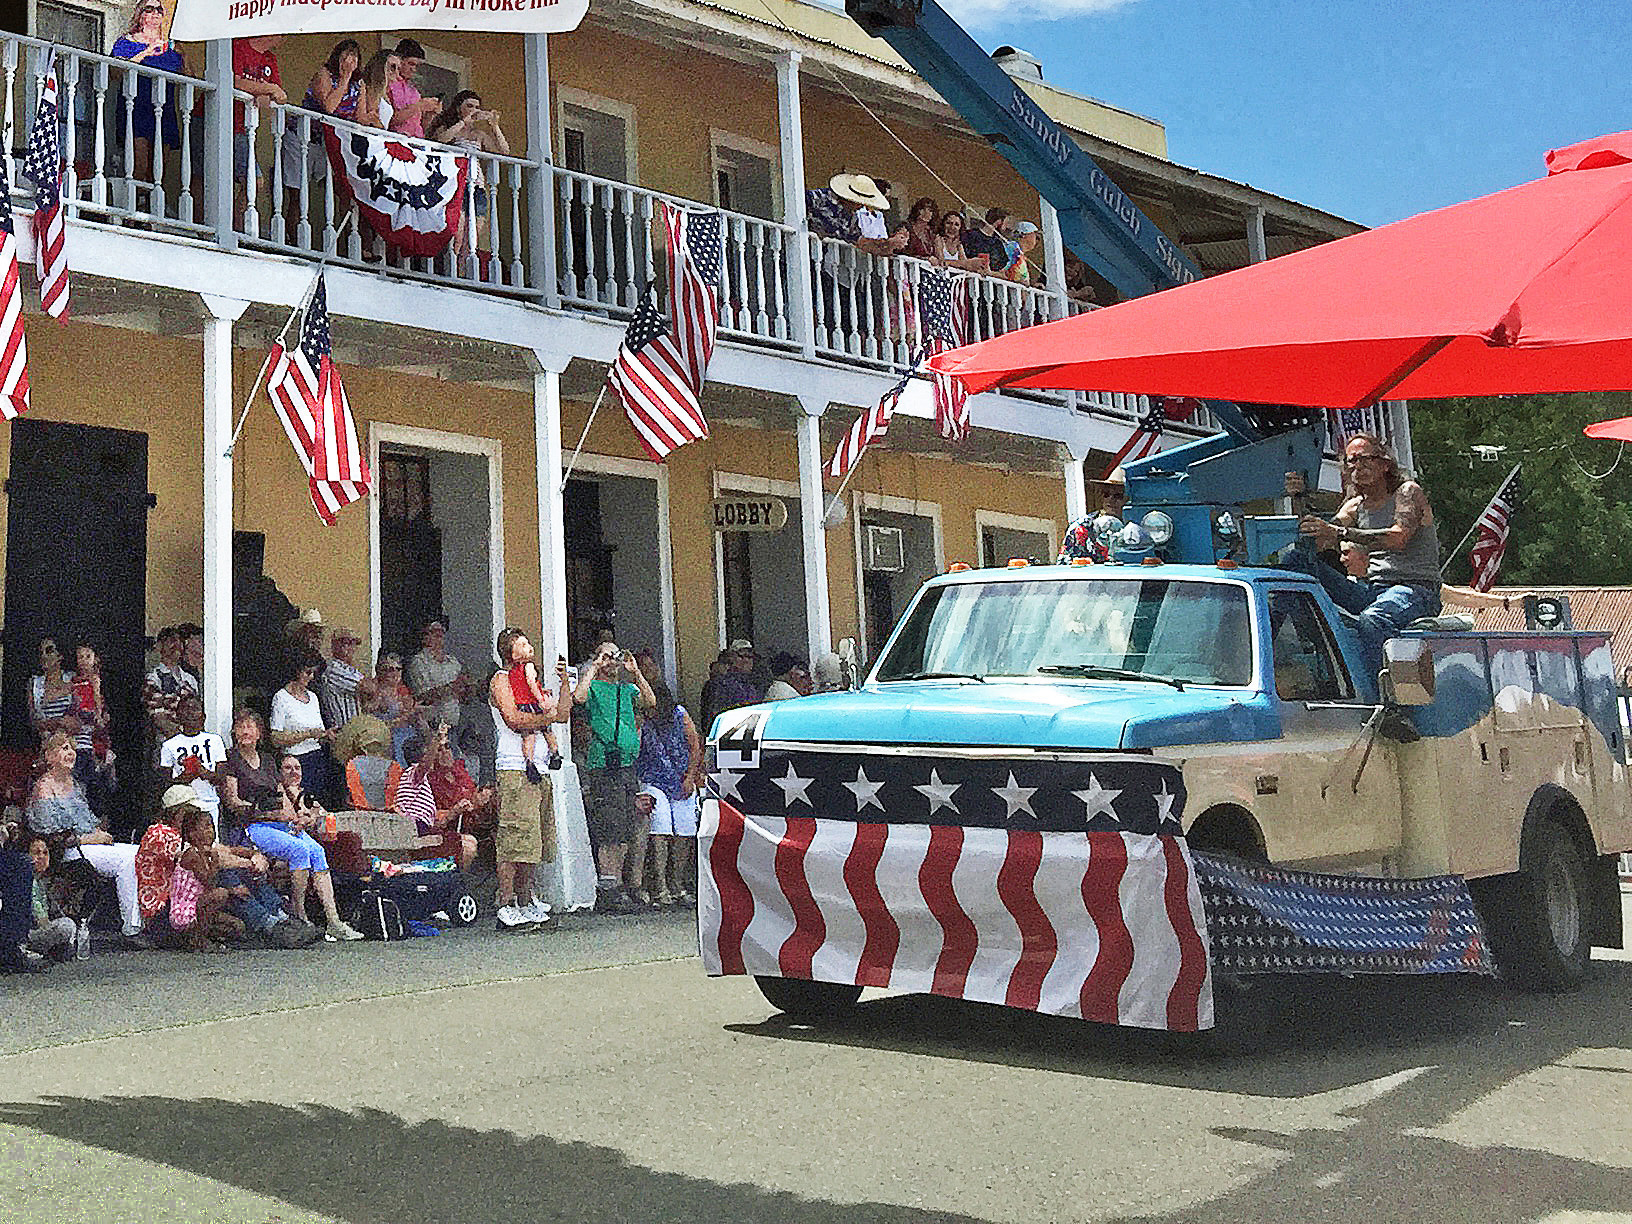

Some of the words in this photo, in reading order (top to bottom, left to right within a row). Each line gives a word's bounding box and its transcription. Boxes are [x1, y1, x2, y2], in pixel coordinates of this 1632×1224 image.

[1011, 89, 1071, 165] Sandy
[1090, 169, 1141, 236] Gulch
[714, 503, 773, 526] LOBBY
[718, 713, 762, 762] 4
